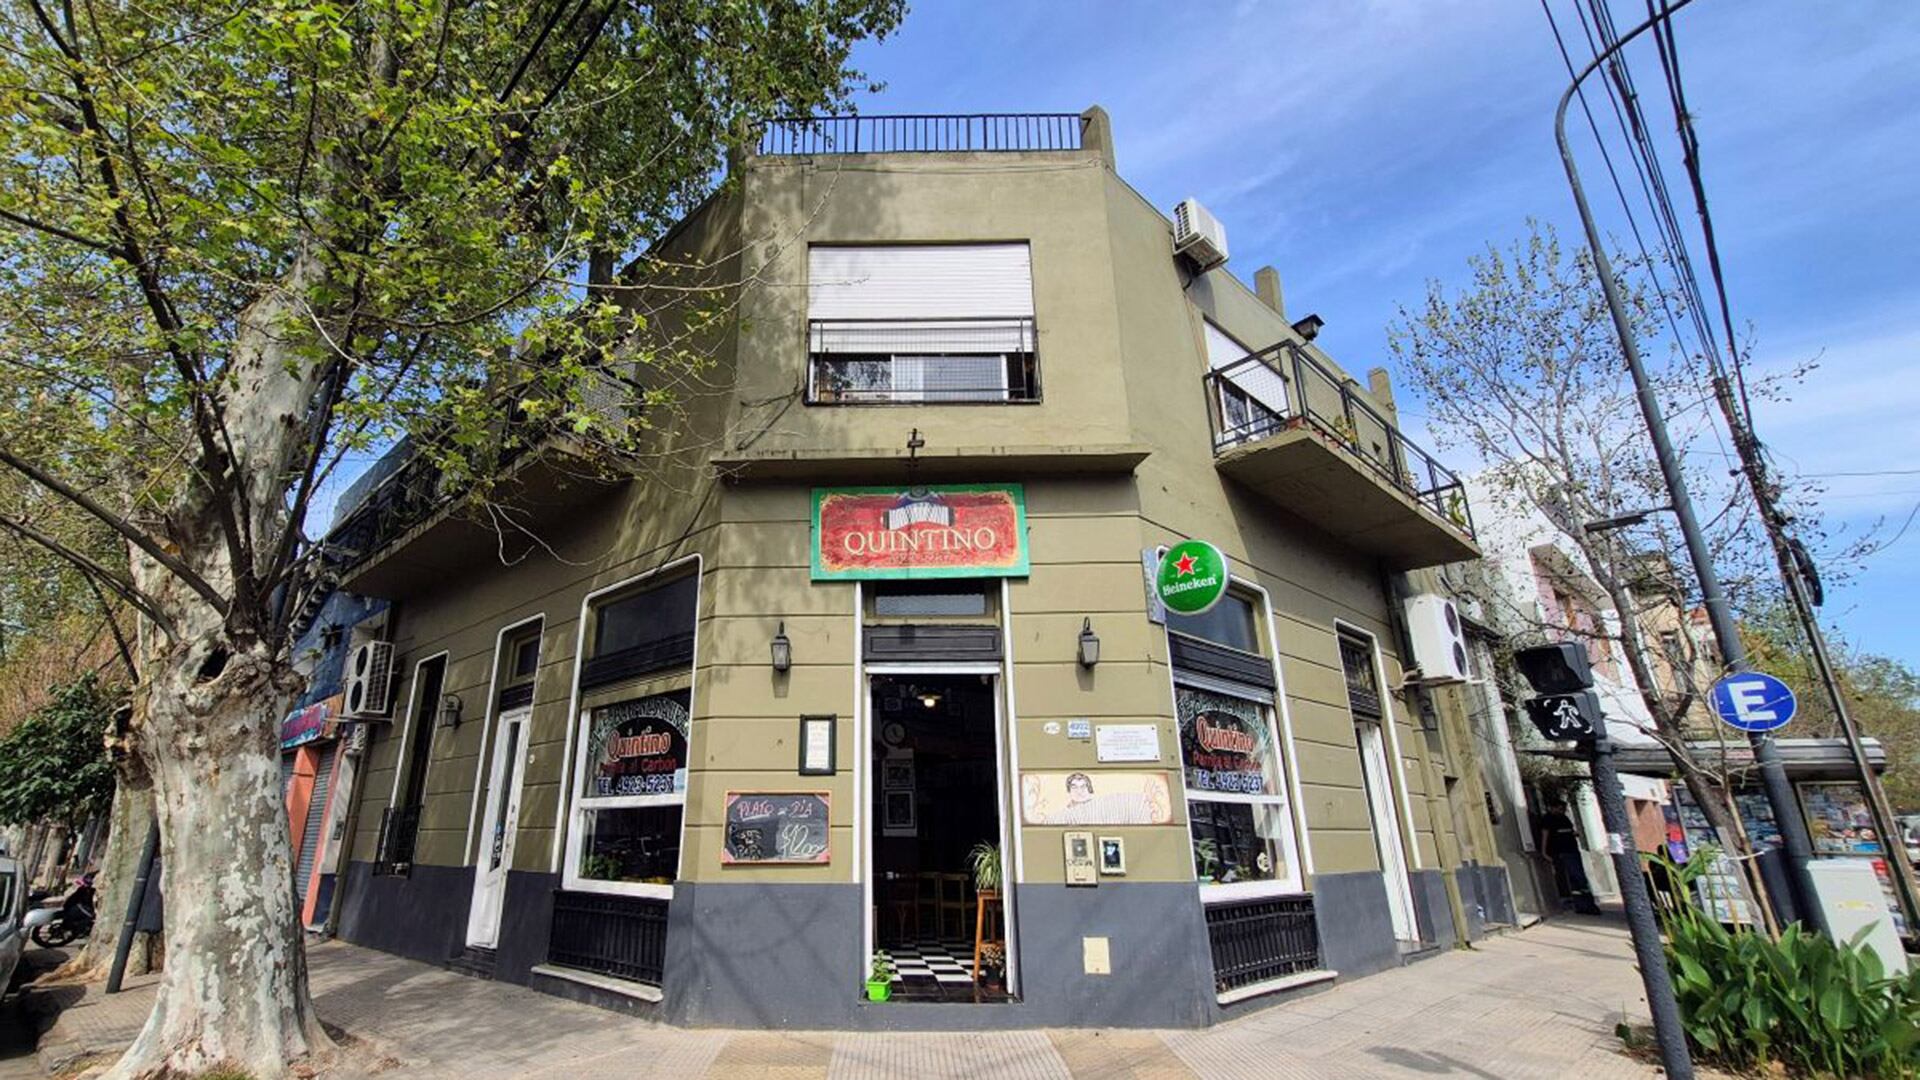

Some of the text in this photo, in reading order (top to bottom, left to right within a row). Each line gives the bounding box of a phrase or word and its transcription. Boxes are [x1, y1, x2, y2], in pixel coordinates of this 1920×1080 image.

[844, 527, 996, 556] QUINTINO
[1162, 576, 1217, 597] Heineken
[1727, 681, 1778, 722] E
[607, 727, 672, 763] Quintino
[1196, 715, 1255, 753] Quintino
